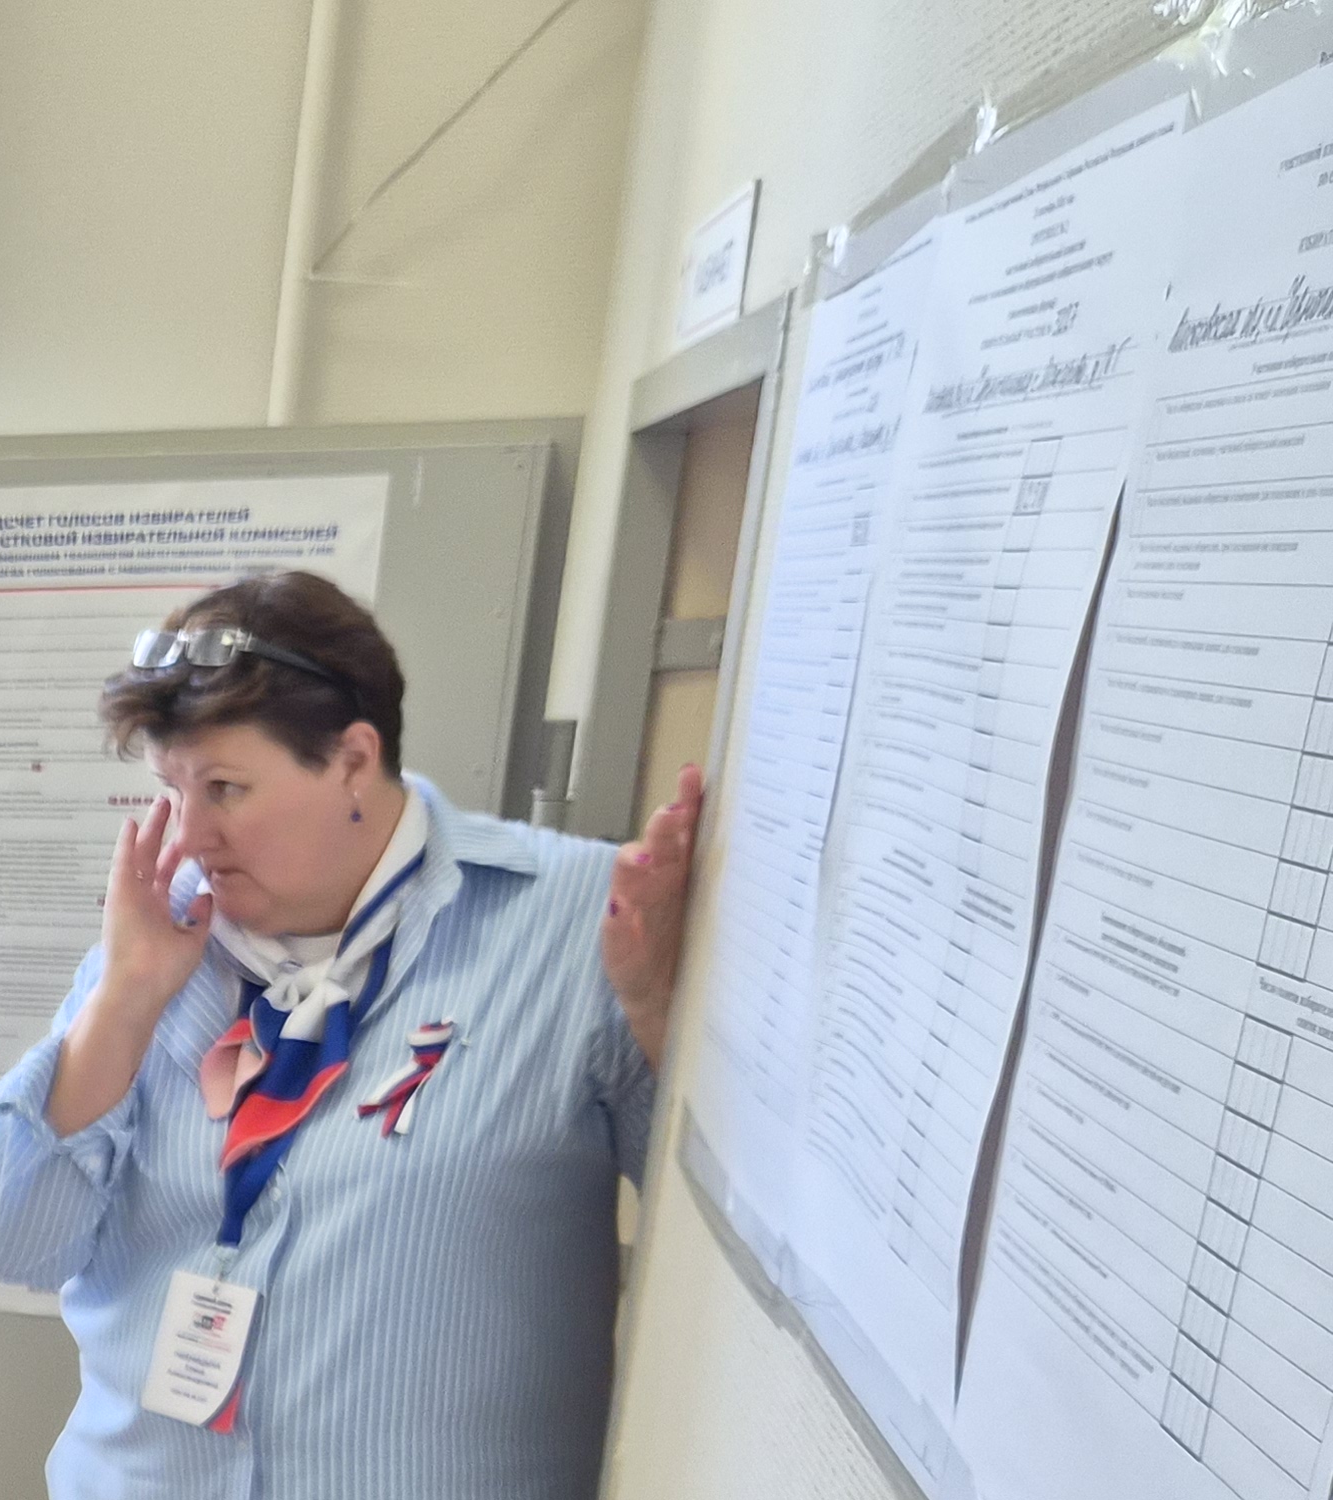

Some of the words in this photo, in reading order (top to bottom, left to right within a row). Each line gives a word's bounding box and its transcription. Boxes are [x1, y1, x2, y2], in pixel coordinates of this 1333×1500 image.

[48, 513, 125, 528] ГОЛОСОВ
[129, 507, 250, 526] ИЗБИРАТЕЛЕЙ
[81, 528, 225, 547] ИЗБИРАТЕЛЬНОЙ
